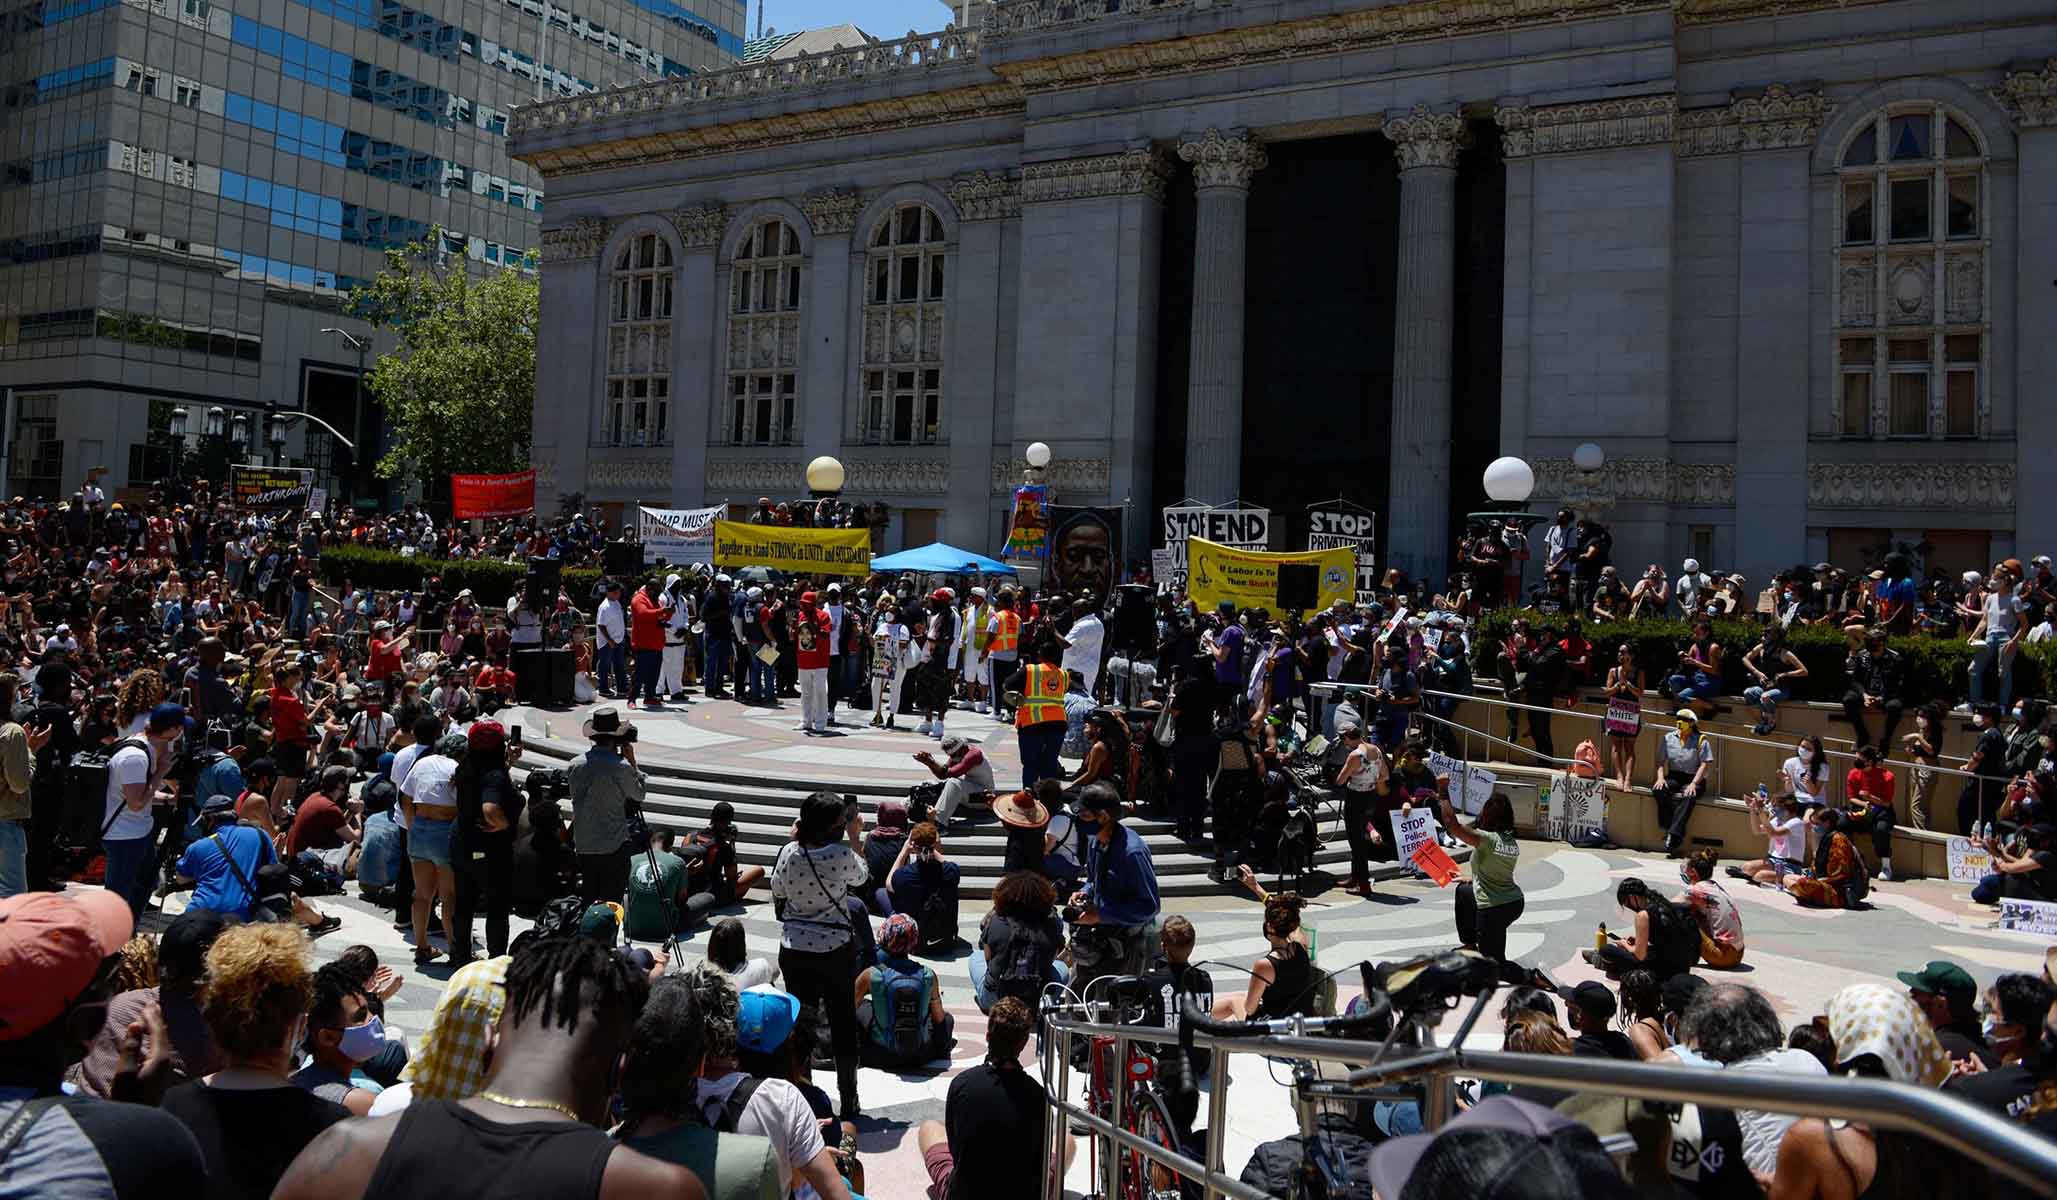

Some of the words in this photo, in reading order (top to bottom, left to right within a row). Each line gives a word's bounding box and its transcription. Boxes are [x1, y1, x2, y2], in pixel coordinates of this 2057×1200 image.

[682, 512, 711, 528] MUST
[1210, 513, 1266, 543] END
[1310, 511, 1372, 536] STOP
[718, 538, 743, 560] Together
[753, 542, 768, 557] stand
[769, 541, 797, 560] STRONG
[1228, 565, 1254, 575] Labor
[1609, 709, 1634, 720] WHITE
[1431, 752, 1453, 770] Black
[1400, 817, 1425, 833] STOP
[1404, 831, 1427, 842] Police
[1401, 838, 1432, 854] TERRO
[1965, 855, 1984, 865] NOT
[1952, 866, 1993, 880] CRIM
